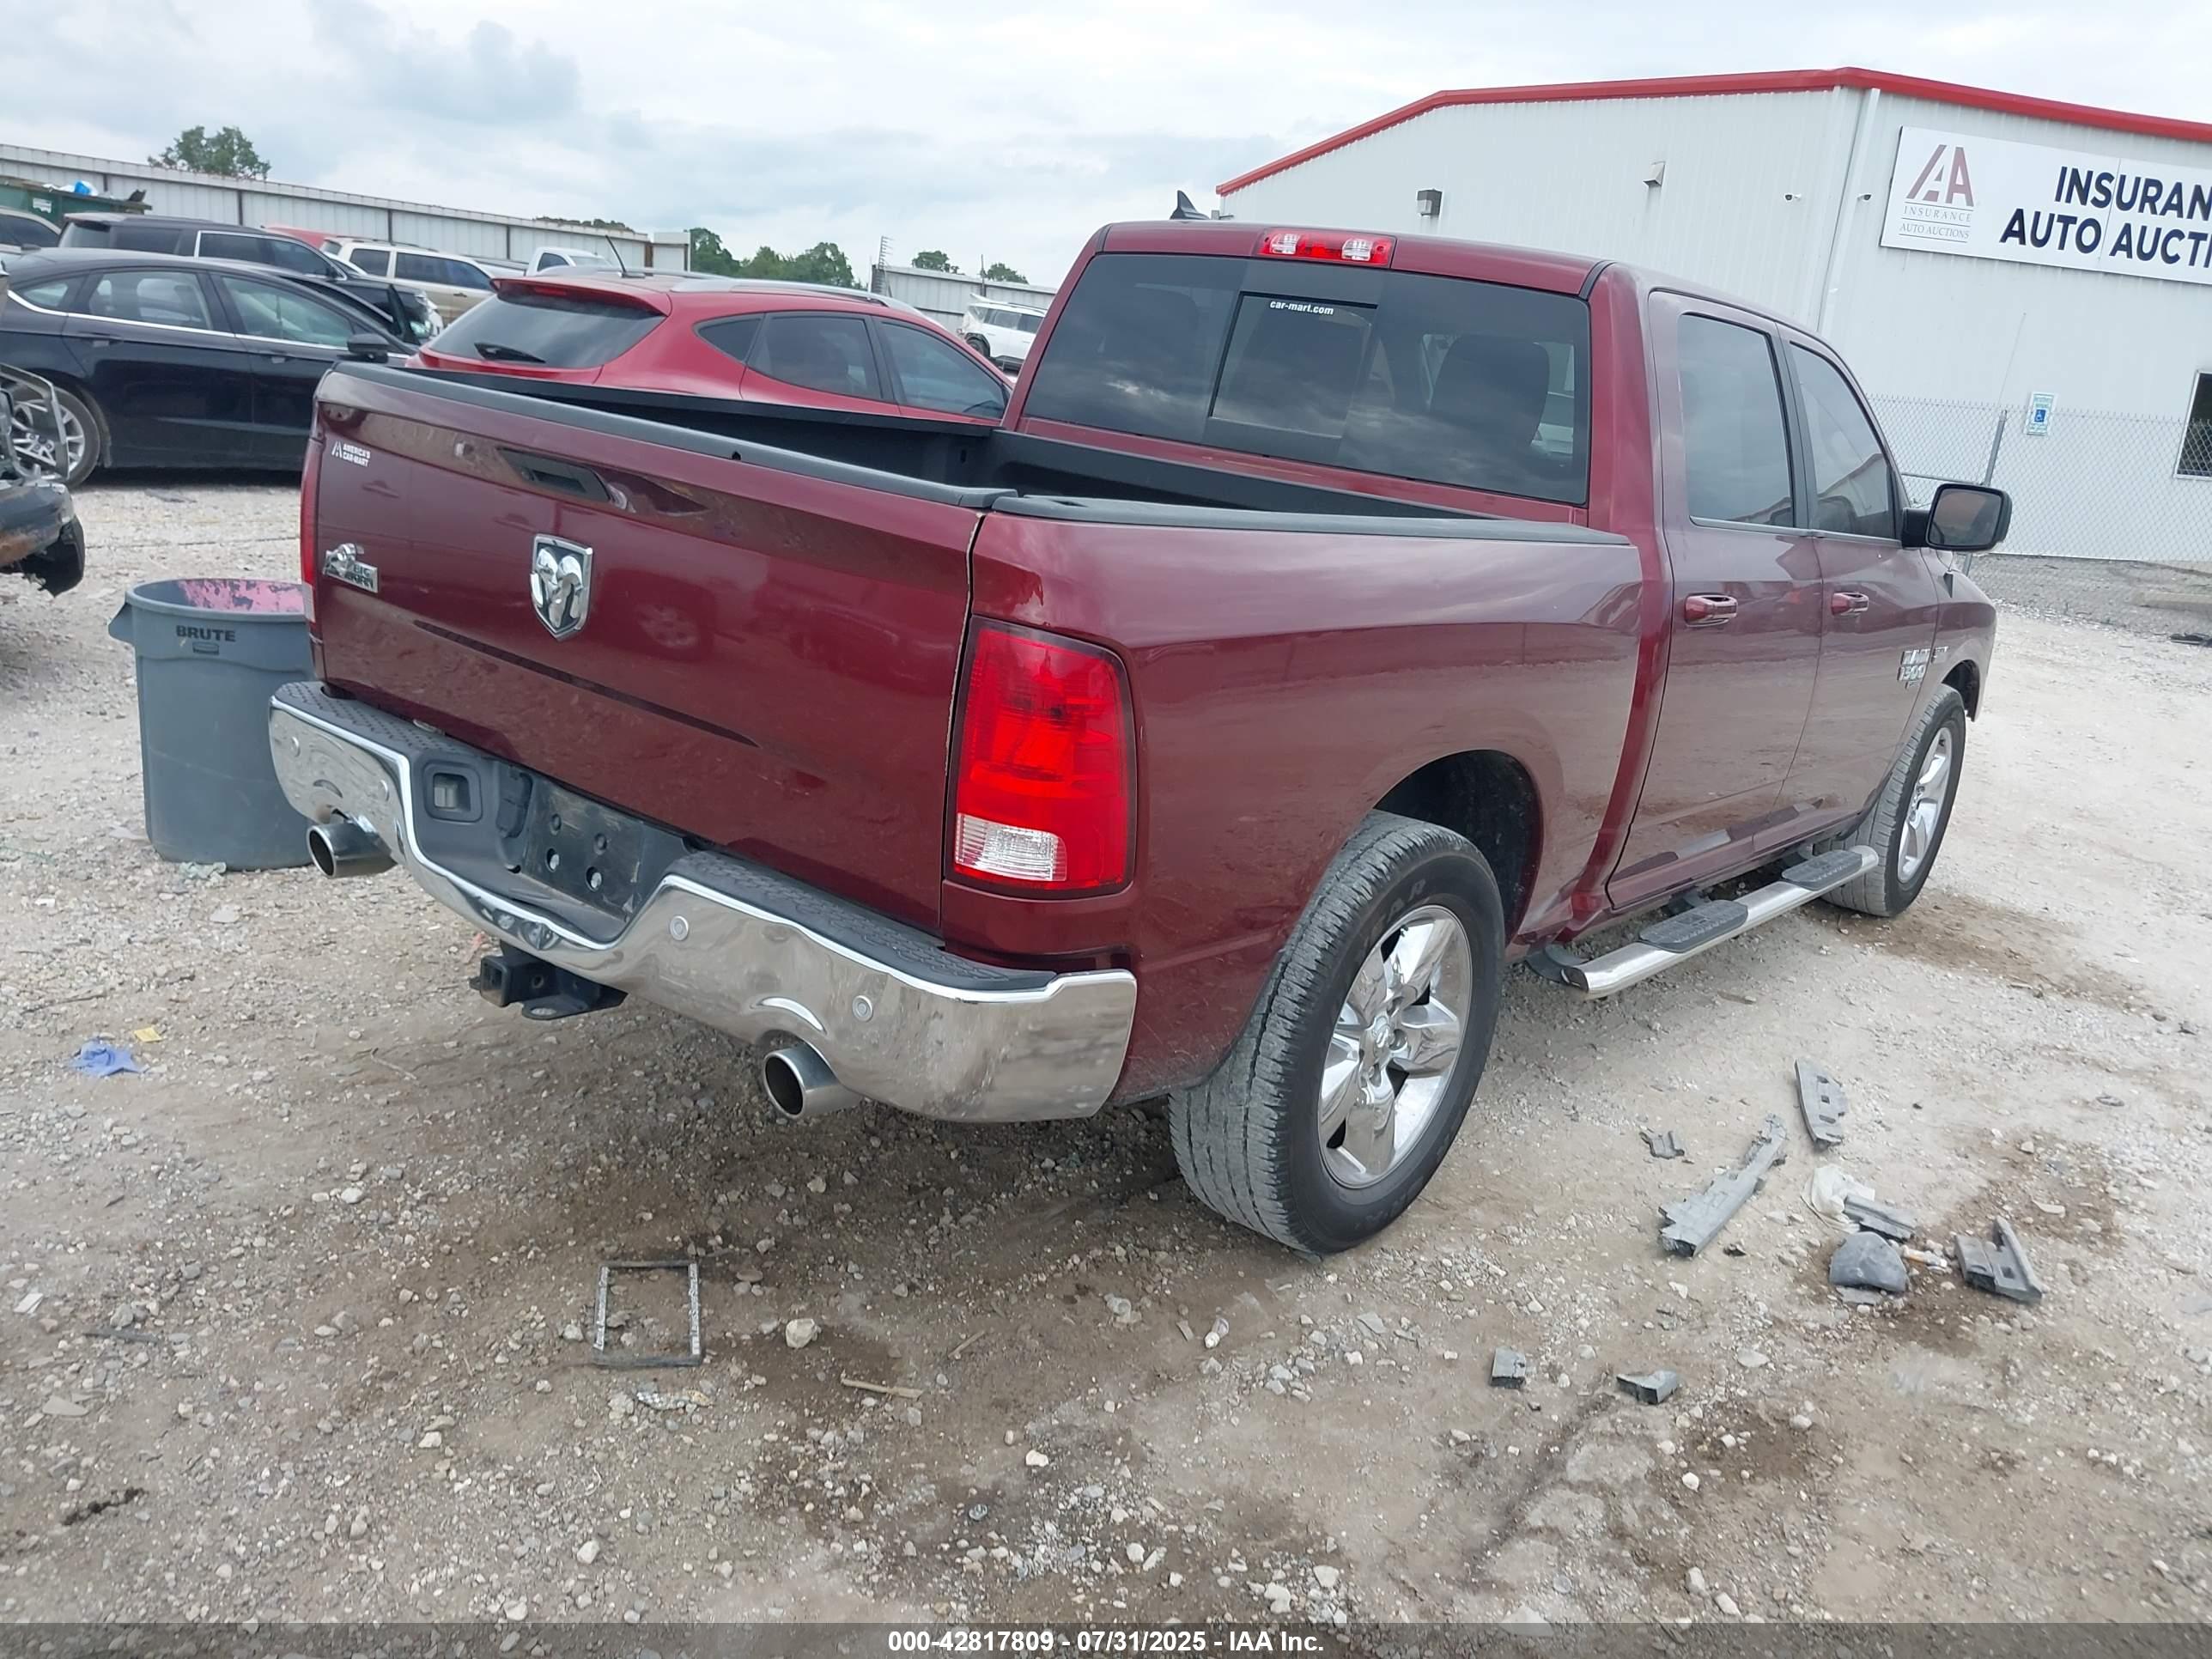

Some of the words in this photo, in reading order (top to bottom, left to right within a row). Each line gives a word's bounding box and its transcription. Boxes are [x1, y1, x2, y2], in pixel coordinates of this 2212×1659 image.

[1904, 206, 1972, 222] INSURANCE
[1899, 222, 1925, 234] AUTO
[1926, 225, 1971, 240] AUCTIONS
[1999, 209, 2102, 254] AUTO
[1270, 301, 1334, 315] car-mart.com
[176, 625, 236, 642] BRUTE
[1898, 665, 1926, 681] 1500
